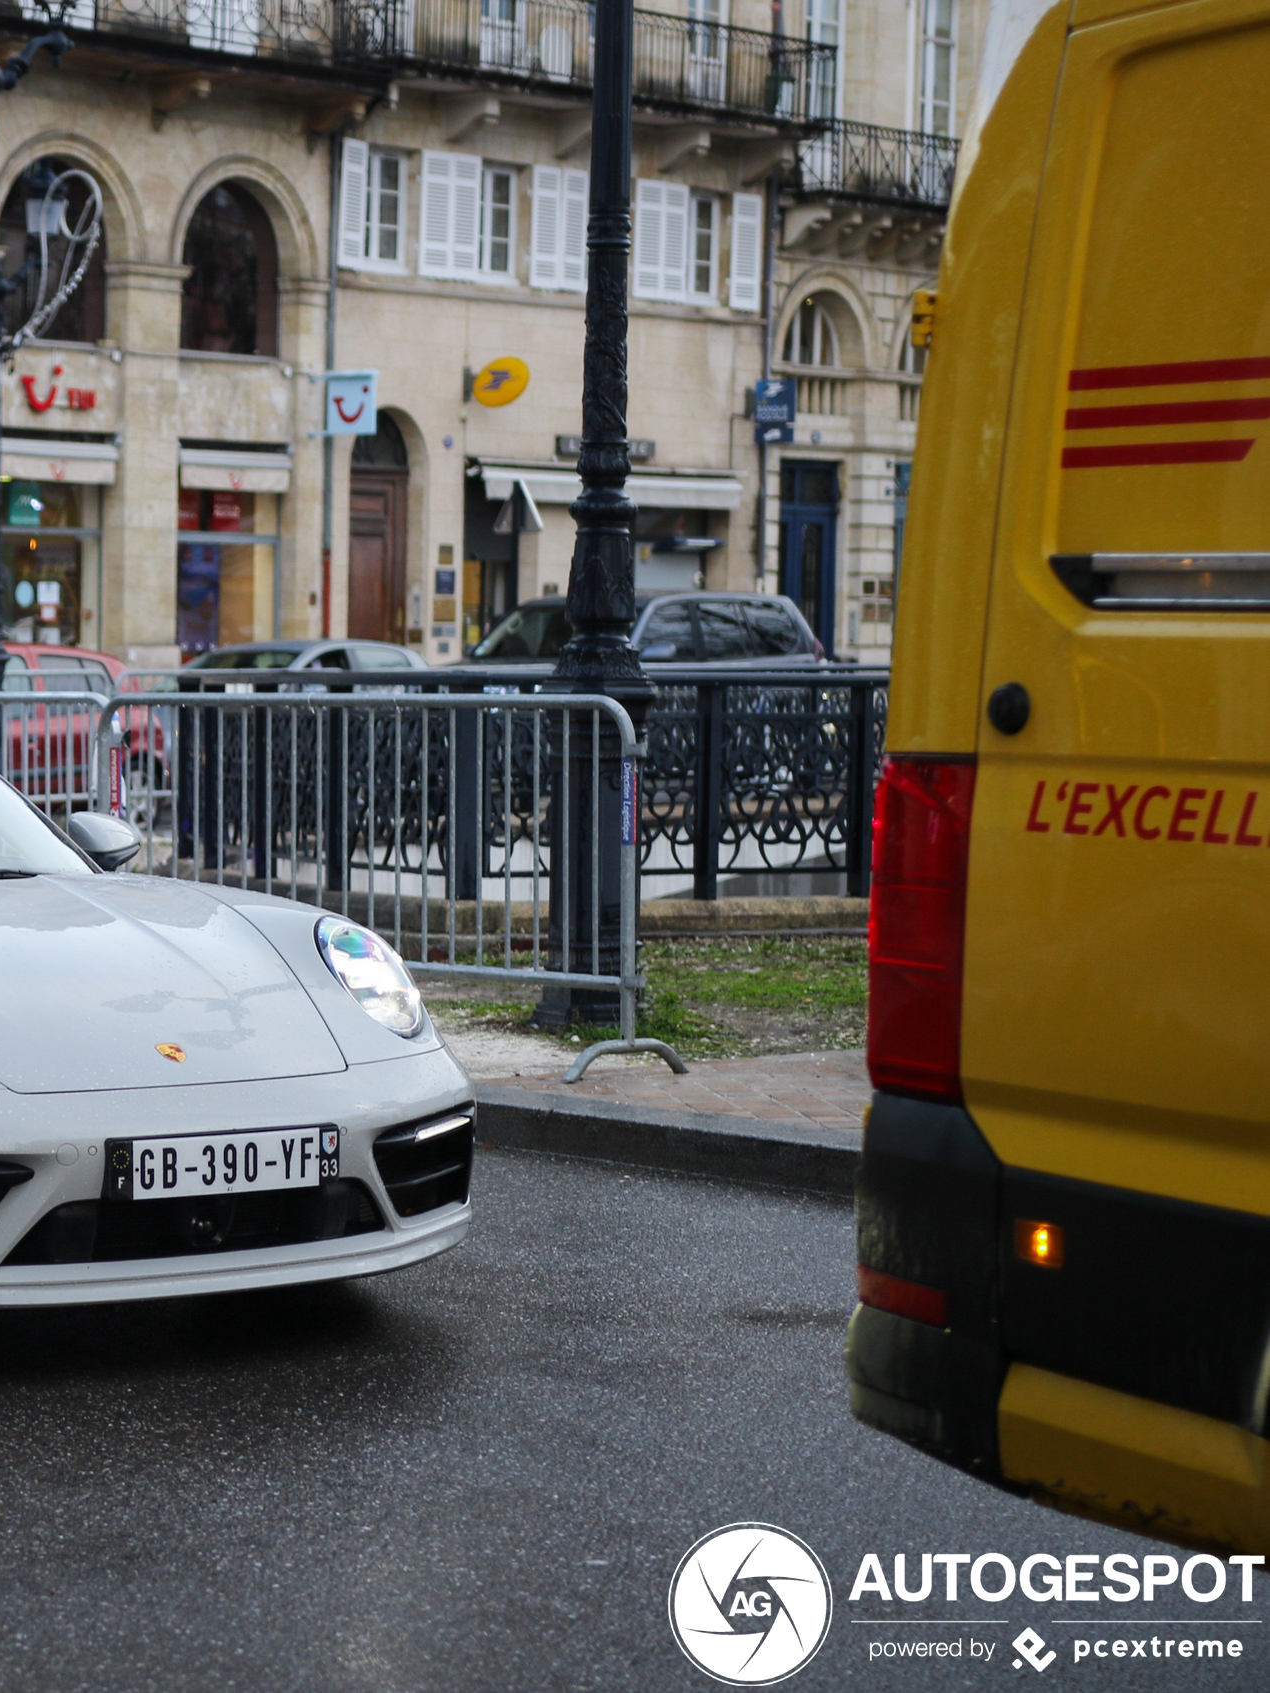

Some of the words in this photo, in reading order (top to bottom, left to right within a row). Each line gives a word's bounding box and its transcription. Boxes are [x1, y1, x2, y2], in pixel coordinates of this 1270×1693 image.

[67, 387, 97, 410] TUI
[623, 762, 632, 799] Direction
[621, 801, 632, 841] Logistique
[1025, 780, 1270, 847] L'EXCELL
[117, 1176, 126, 1189] F
[140, 1137, 314, 1190] GB-390-YF
[321, 1158, 338, 1177] 33
